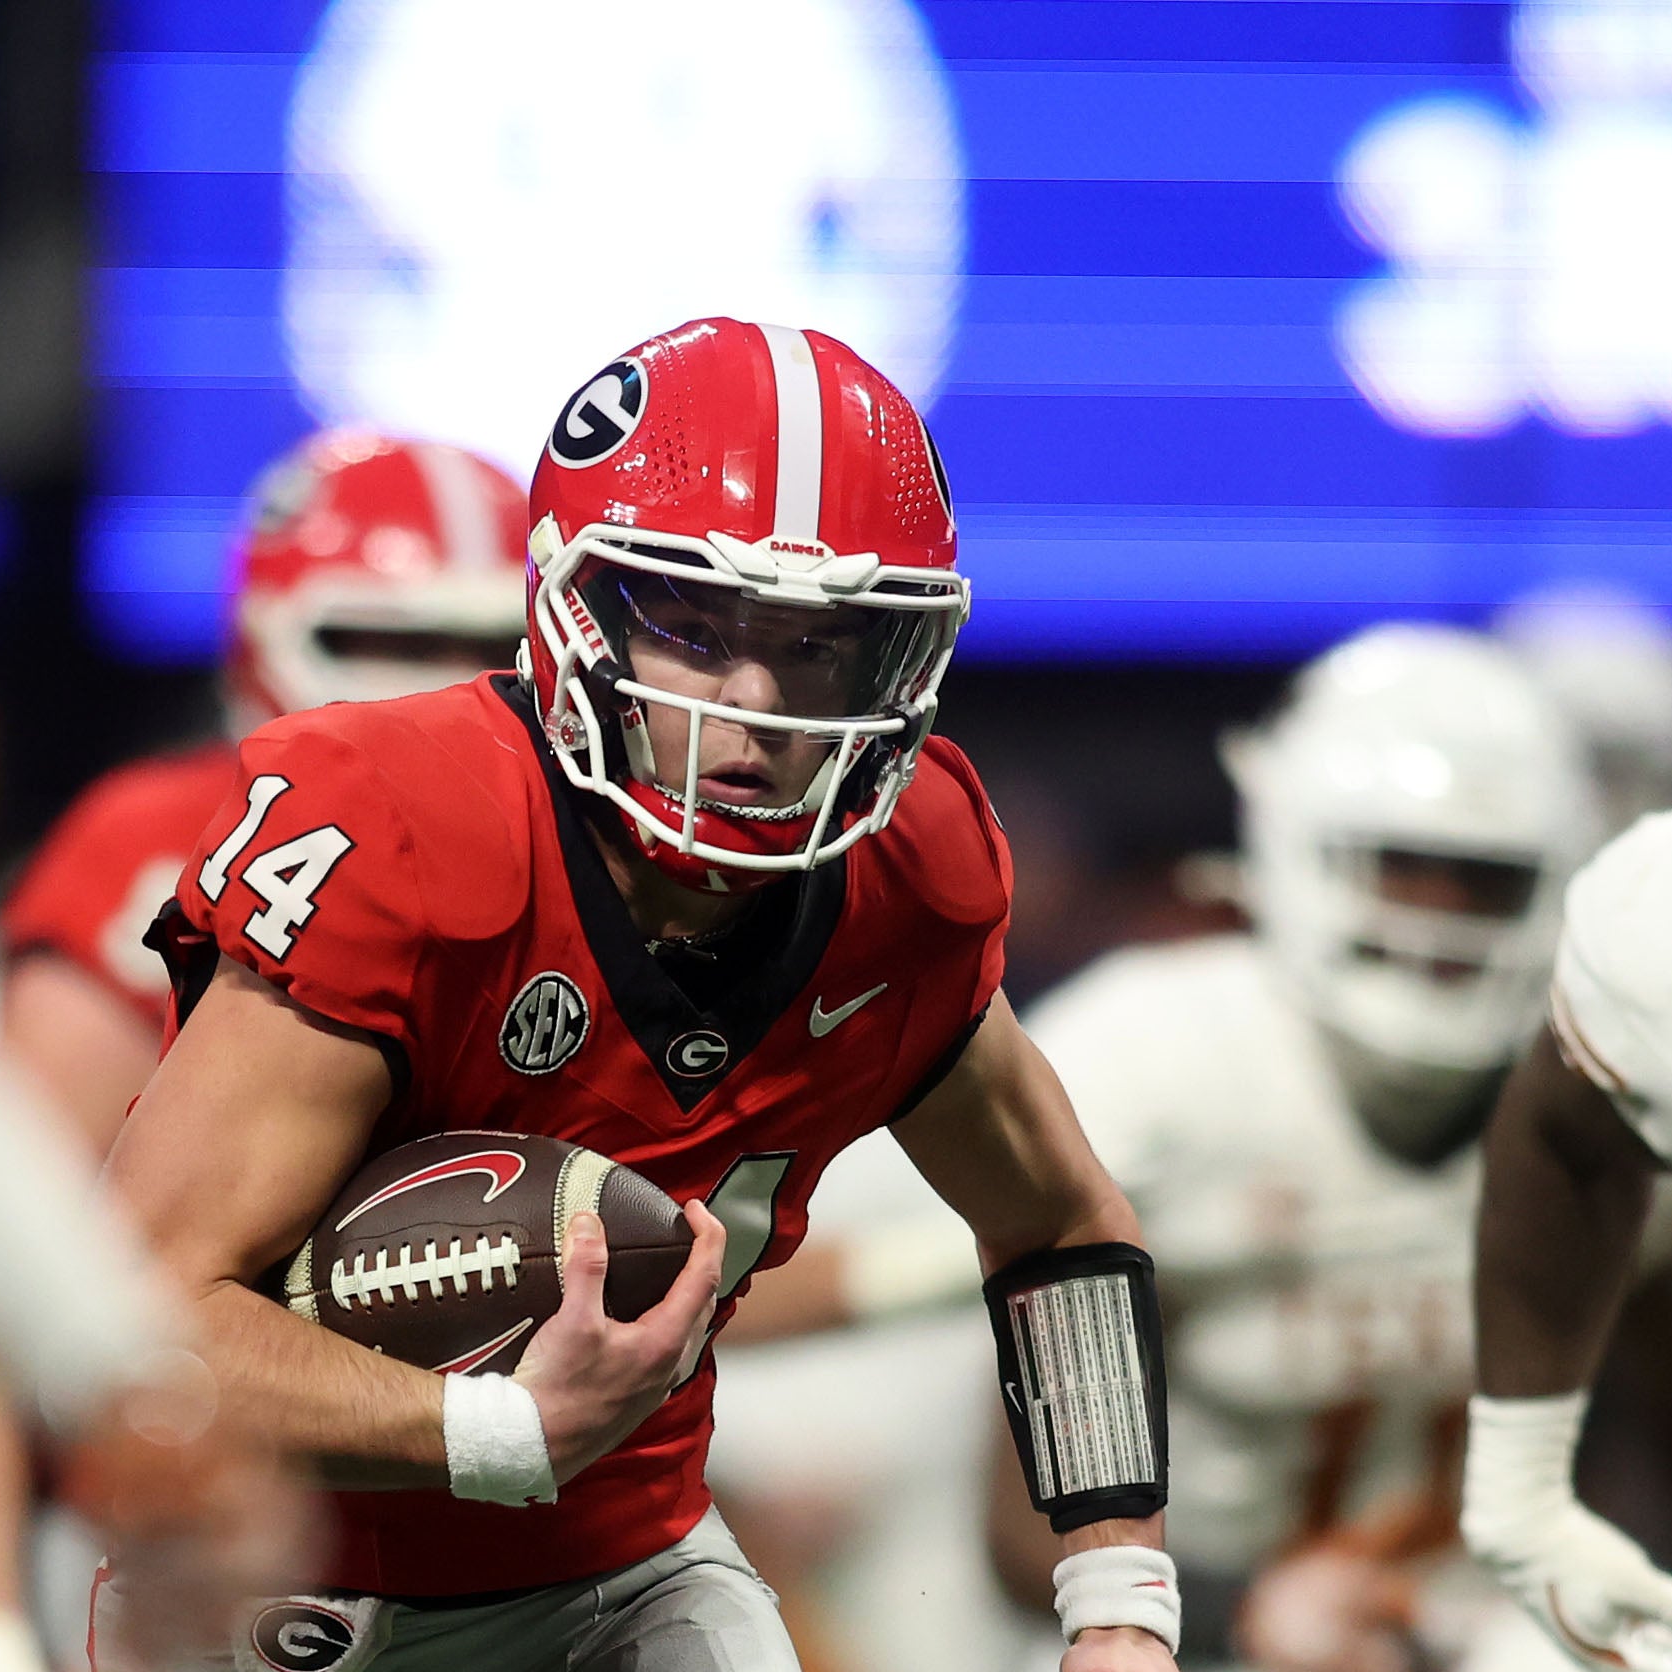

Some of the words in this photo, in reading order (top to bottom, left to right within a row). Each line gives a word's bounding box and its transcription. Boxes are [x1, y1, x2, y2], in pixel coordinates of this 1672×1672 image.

[549, 357, 646, 464] G
[769, 540, 825, 557] DAWGS
[198, 773, 355, 963] 14
[507, 979, 581, 1066] SEC
